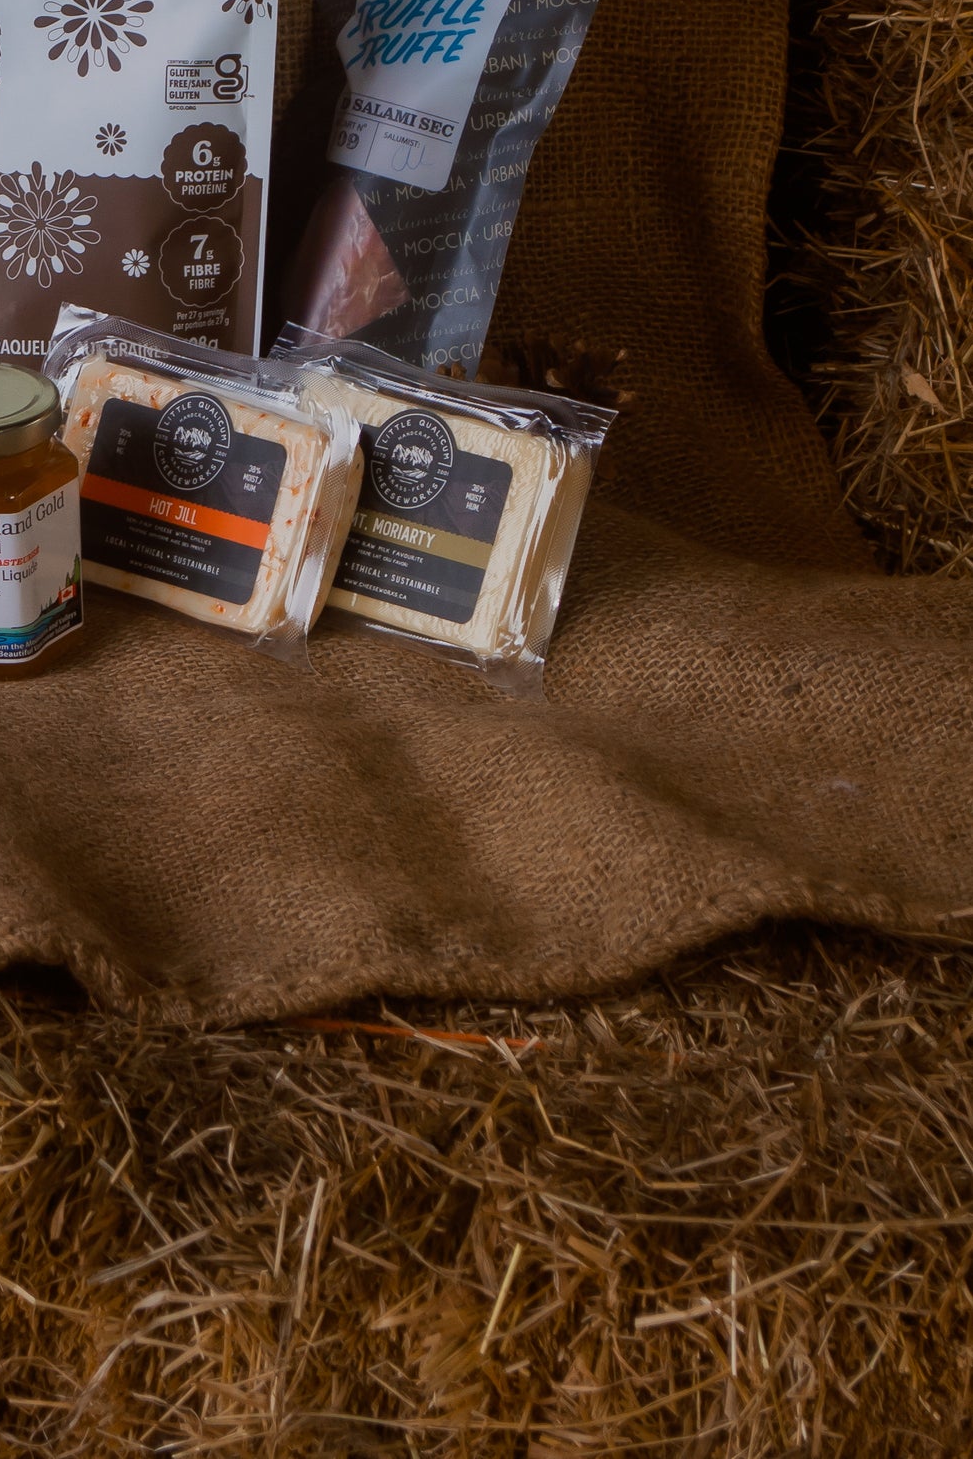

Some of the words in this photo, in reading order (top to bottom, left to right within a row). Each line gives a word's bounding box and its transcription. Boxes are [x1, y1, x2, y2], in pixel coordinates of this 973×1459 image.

[347, 29, 476, 69] TRUFFE
[169, 68, 200, 77] GLUTEN
[169, 79, 211, 90] FREE/SANS
[169, 91, 200, 99] GLUTEN
[352, 99, 417, 127] SALAMI
[418, 117, 454, 138] SEC
[470, 106, 533, 131] URBANI
[175, 169, 234, 183] PROTEIN
[181, 183, 227, 196] PROTÉINE
[404, 231, 474, 257] MOCCIA
[183, 263, 221, 278] FIBRE
[189, 278, 216, 290] FIBRE
[412, 286, 480, 310] MOCCIA
[173, 323, 184, 332] par
[184, 319, 206, 331] portion
[207, 318, 215, 327] de
[215, 316, 224, 325] 27
[177, 311, 188, 320] Per
[189, 311, 197, 320] 27
[164, 401, 192, 426] LITTLE
[198, 401, 227, 441] QUALICUM
[382, 419, 412, 444] LITTLE
[418, 419, 450, 460] QUALICUM
[398, 430, 437, 451] HANDCRAFTED
[158, 450, 217, 485] CHEESEWORKS
[376, 468, 438, 504] CHEESEWORKS
[36, 491, 65, 522] Gold
[149, 497, 173, 518] HOT
[174, 506, 197, 526] JILL
[155, 524, 173, 534] CHEESE
[372, 517, 436, 549] MORIARTY
[105, 535, 127, 548] LOCAL
[136, 544, 164, 559] ETHICAL
[173, 555, 220, 575] SUSTAINABLE
[392, 549, 424, 564] FAVOURITE
[2, 561, 39, 583] Liquide
[351, 562, 381, 578] ETHICAL
[391, 574, 441, 595] SUSTAINABLE
